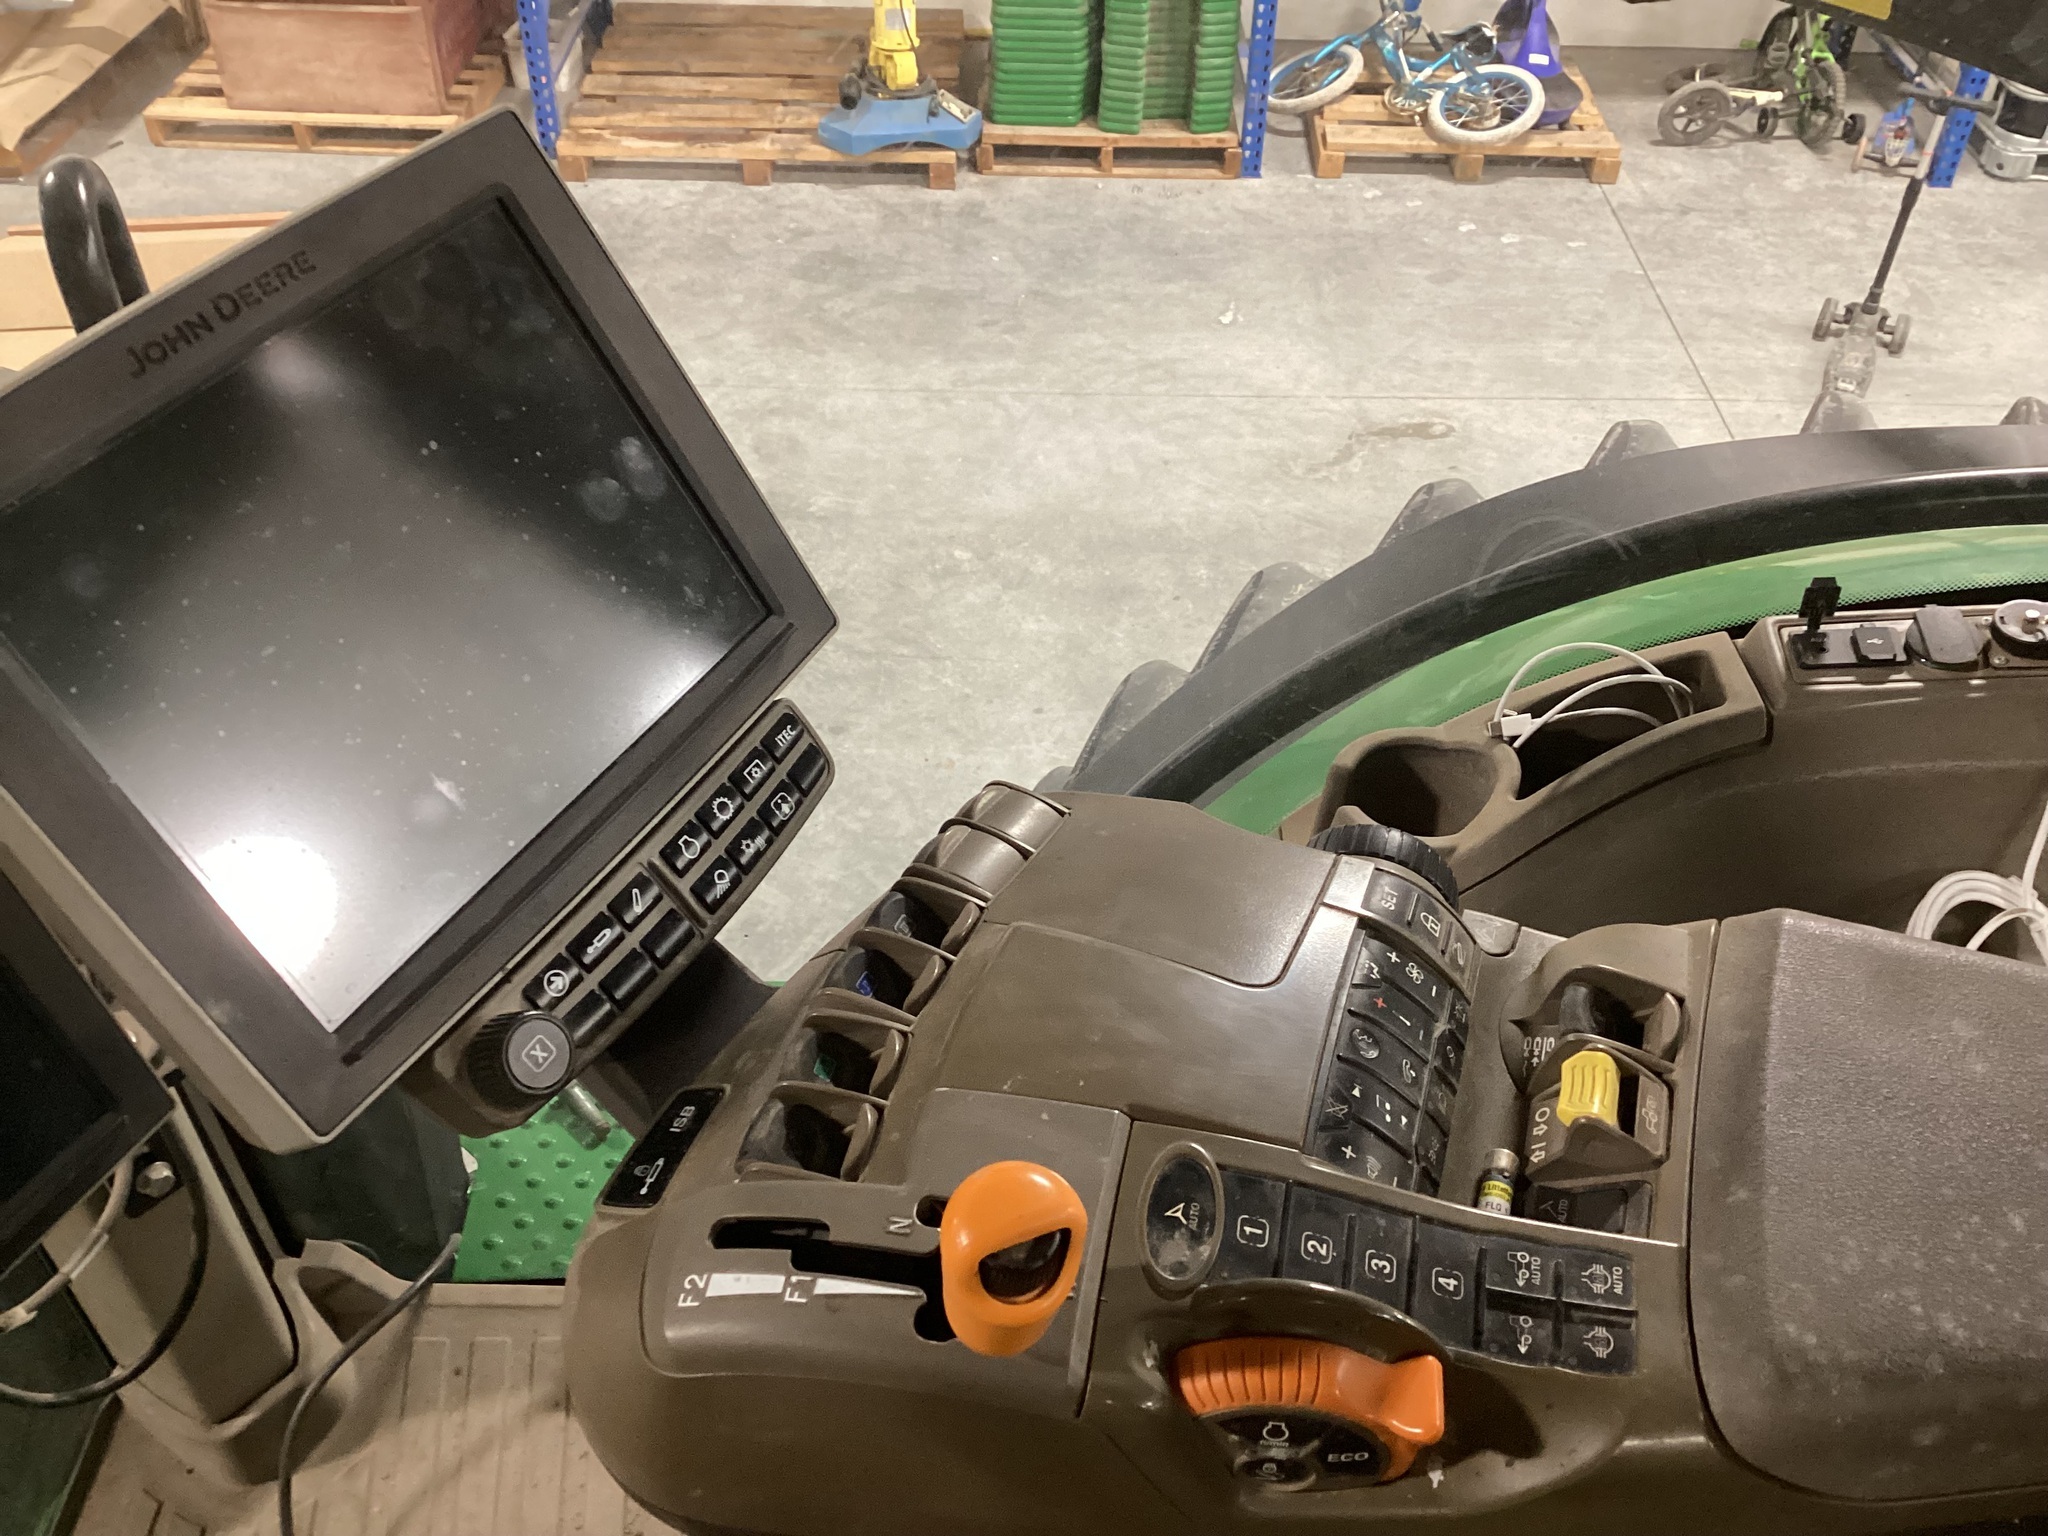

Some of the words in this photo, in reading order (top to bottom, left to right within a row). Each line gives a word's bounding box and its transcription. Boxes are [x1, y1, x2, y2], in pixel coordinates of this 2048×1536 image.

[124, 310, 215, 379] JOHN
[211, 249, 317, 323] DEERE
[1380, 885, 1399, 911] SET
[1188, 1202, 1200, 1231] AUTO
[1556, 1199, 1569, 1223] AUTO
[886, 1215, 913, 1235] N
[1306, 1239, 1328, 1257] 2
[1370, 1258, 1391, 1274] 3
[1530, 1256, 1542, 1286] AUTO
[677, 1273, 709, 1308] F2
[783, 1275, 814, 1304] F1
[1438, 1275, 1459, 1292] 4
[1611, 1265, 1624, 1296] AUTO
[1327, 1451, 1369, 1463] ECO
